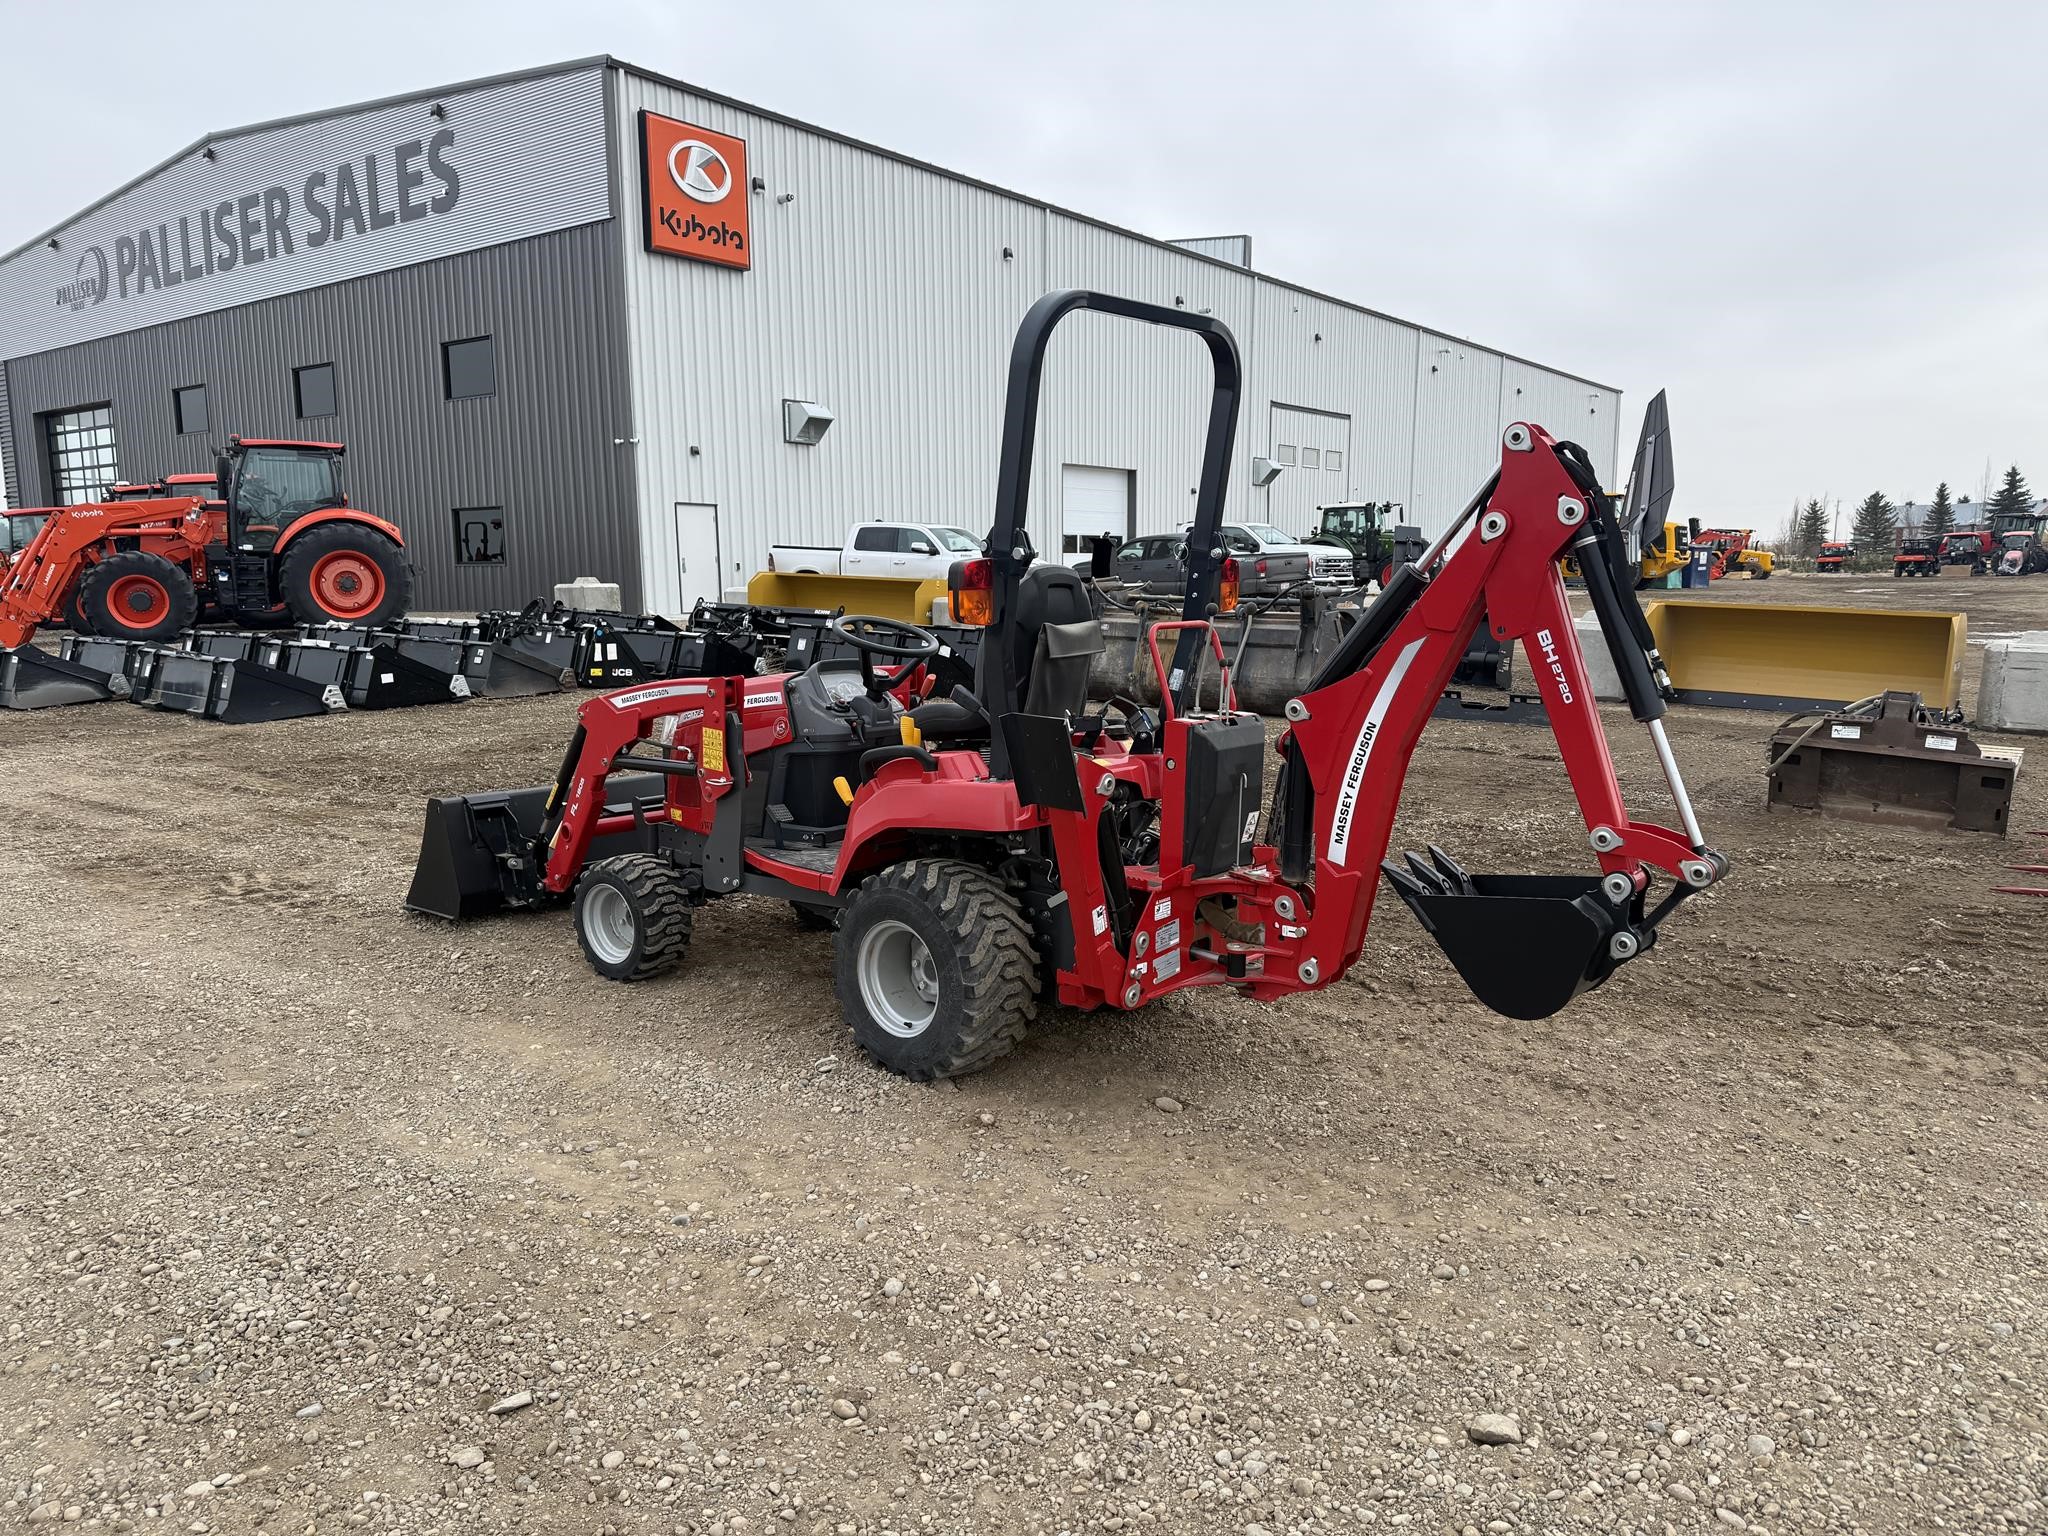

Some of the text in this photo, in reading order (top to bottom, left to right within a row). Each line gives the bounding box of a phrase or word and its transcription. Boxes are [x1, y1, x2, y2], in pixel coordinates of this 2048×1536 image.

[115, 129, 460, 299] PALLISER SALES
[659, 206, 744, 249] Kubota
[71, 509, 104, 518] Kubota
[612, 668, 633, 676] JCB
[621, 688, 669, 704] MASSEY FERGUSON
[746, 695, 778, 705] FERGUSON
[1334, 721, 1377, 845] MASSEY FERGUSON
[570, 802, 579, 817] FL
